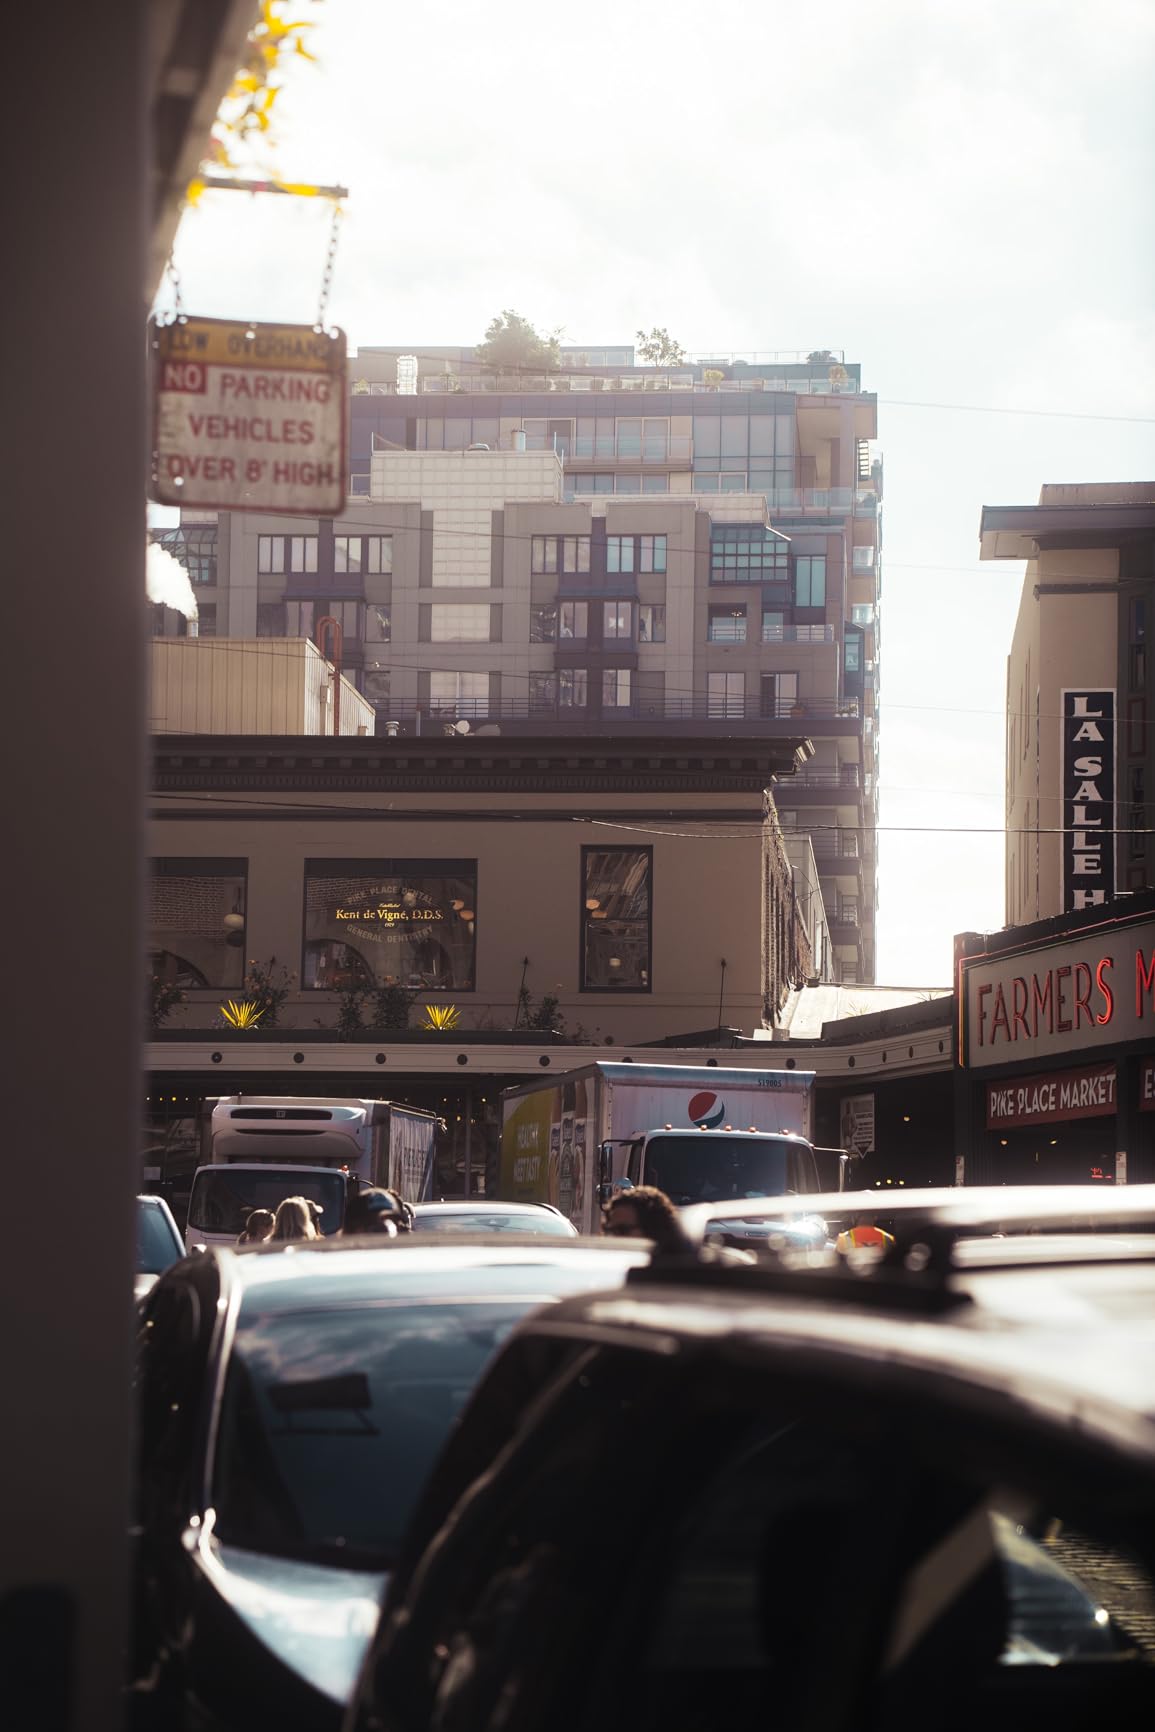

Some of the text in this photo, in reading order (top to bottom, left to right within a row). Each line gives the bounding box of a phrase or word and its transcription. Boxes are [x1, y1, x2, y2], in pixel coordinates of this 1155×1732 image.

[165, 363, 331, 405] NO PARKING
[187, 413, 315, 445] VEHICLES
[166, 454, 236, 482] OVER
[273, 460, 335, 487] HIGH
[370, 886, 398, 895] PLACE
[336, 909, 360, 920] Kent
[363, 909, 376, 919] de
[412, 909, 444, 920] D.D.S.
[346, 923, 433, 943] GENERAL DENTISTRY
[977, 956, 1114, 1047] FARMERS
[990, 1072, 1116, 1118] PIKE PLACE MARKET
[1144, 1069, 1155, 1098] E
